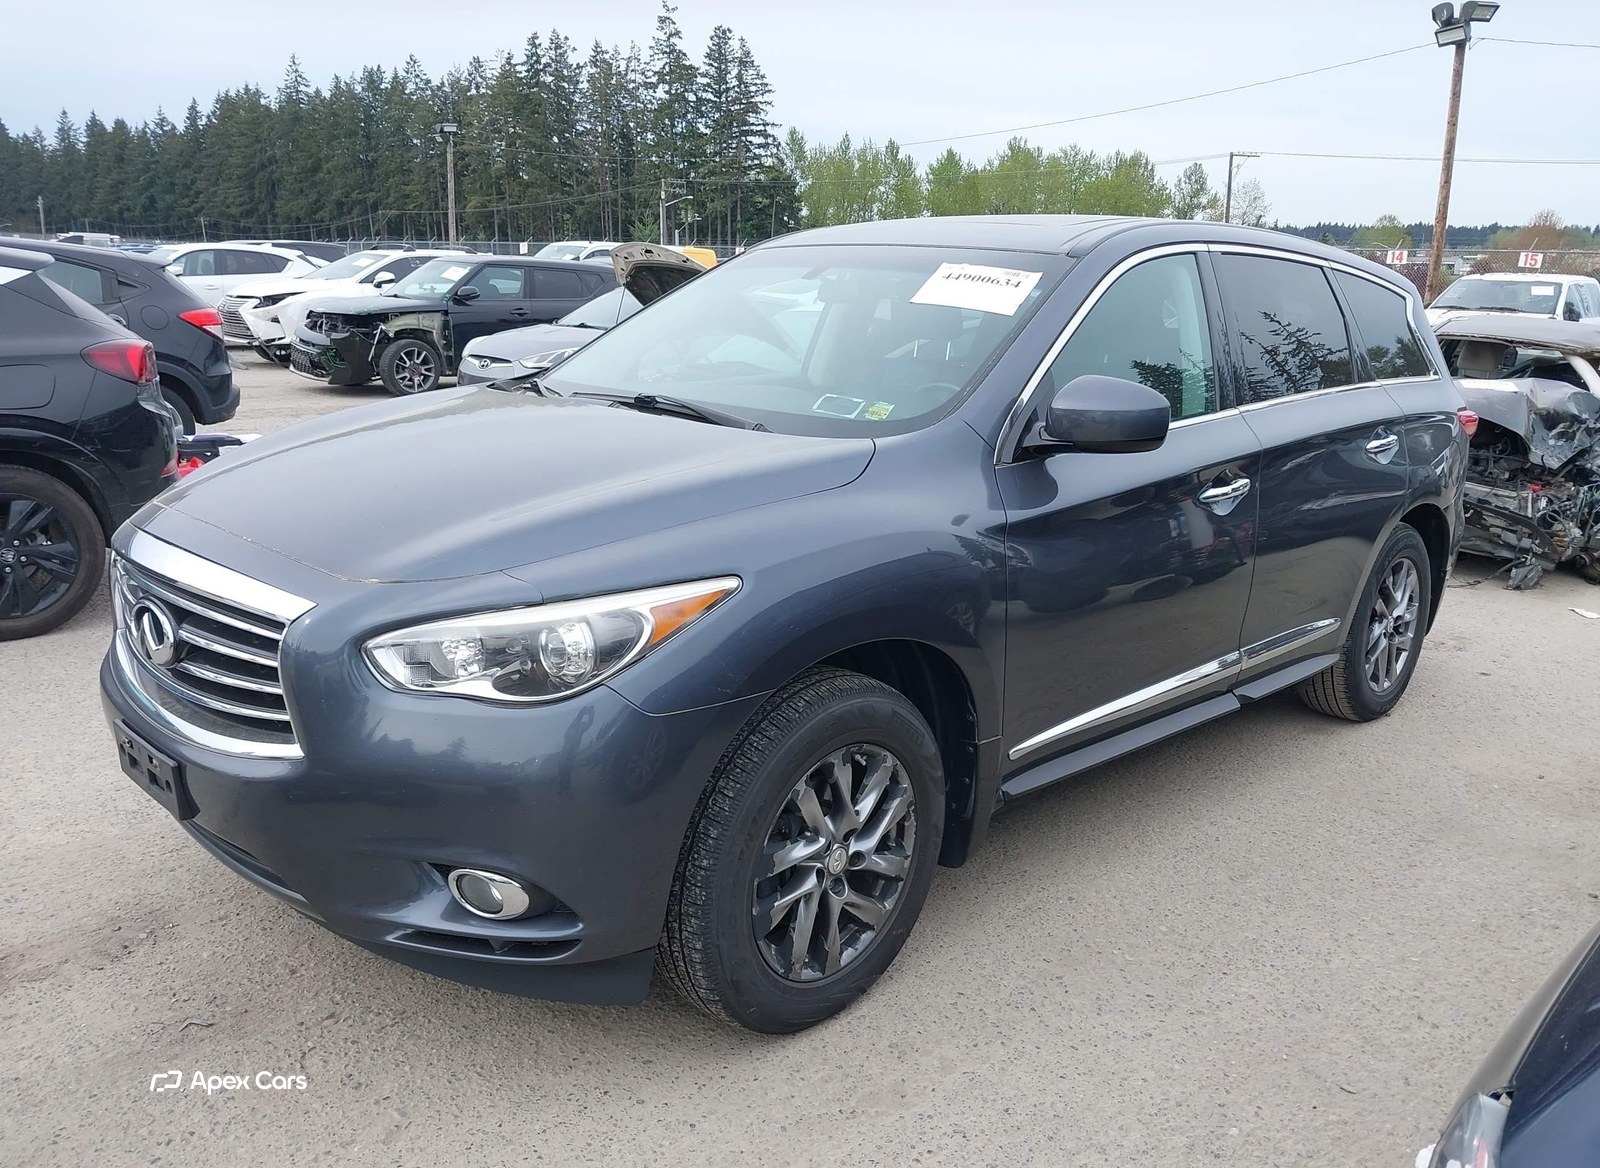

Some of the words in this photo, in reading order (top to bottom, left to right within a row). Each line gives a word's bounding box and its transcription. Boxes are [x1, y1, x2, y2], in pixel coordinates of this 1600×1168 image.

[1390, 251, 1404, 263] 14
[1523, 253, 1539, 267] 15
[941, 272, 1023, 289] 44900634
